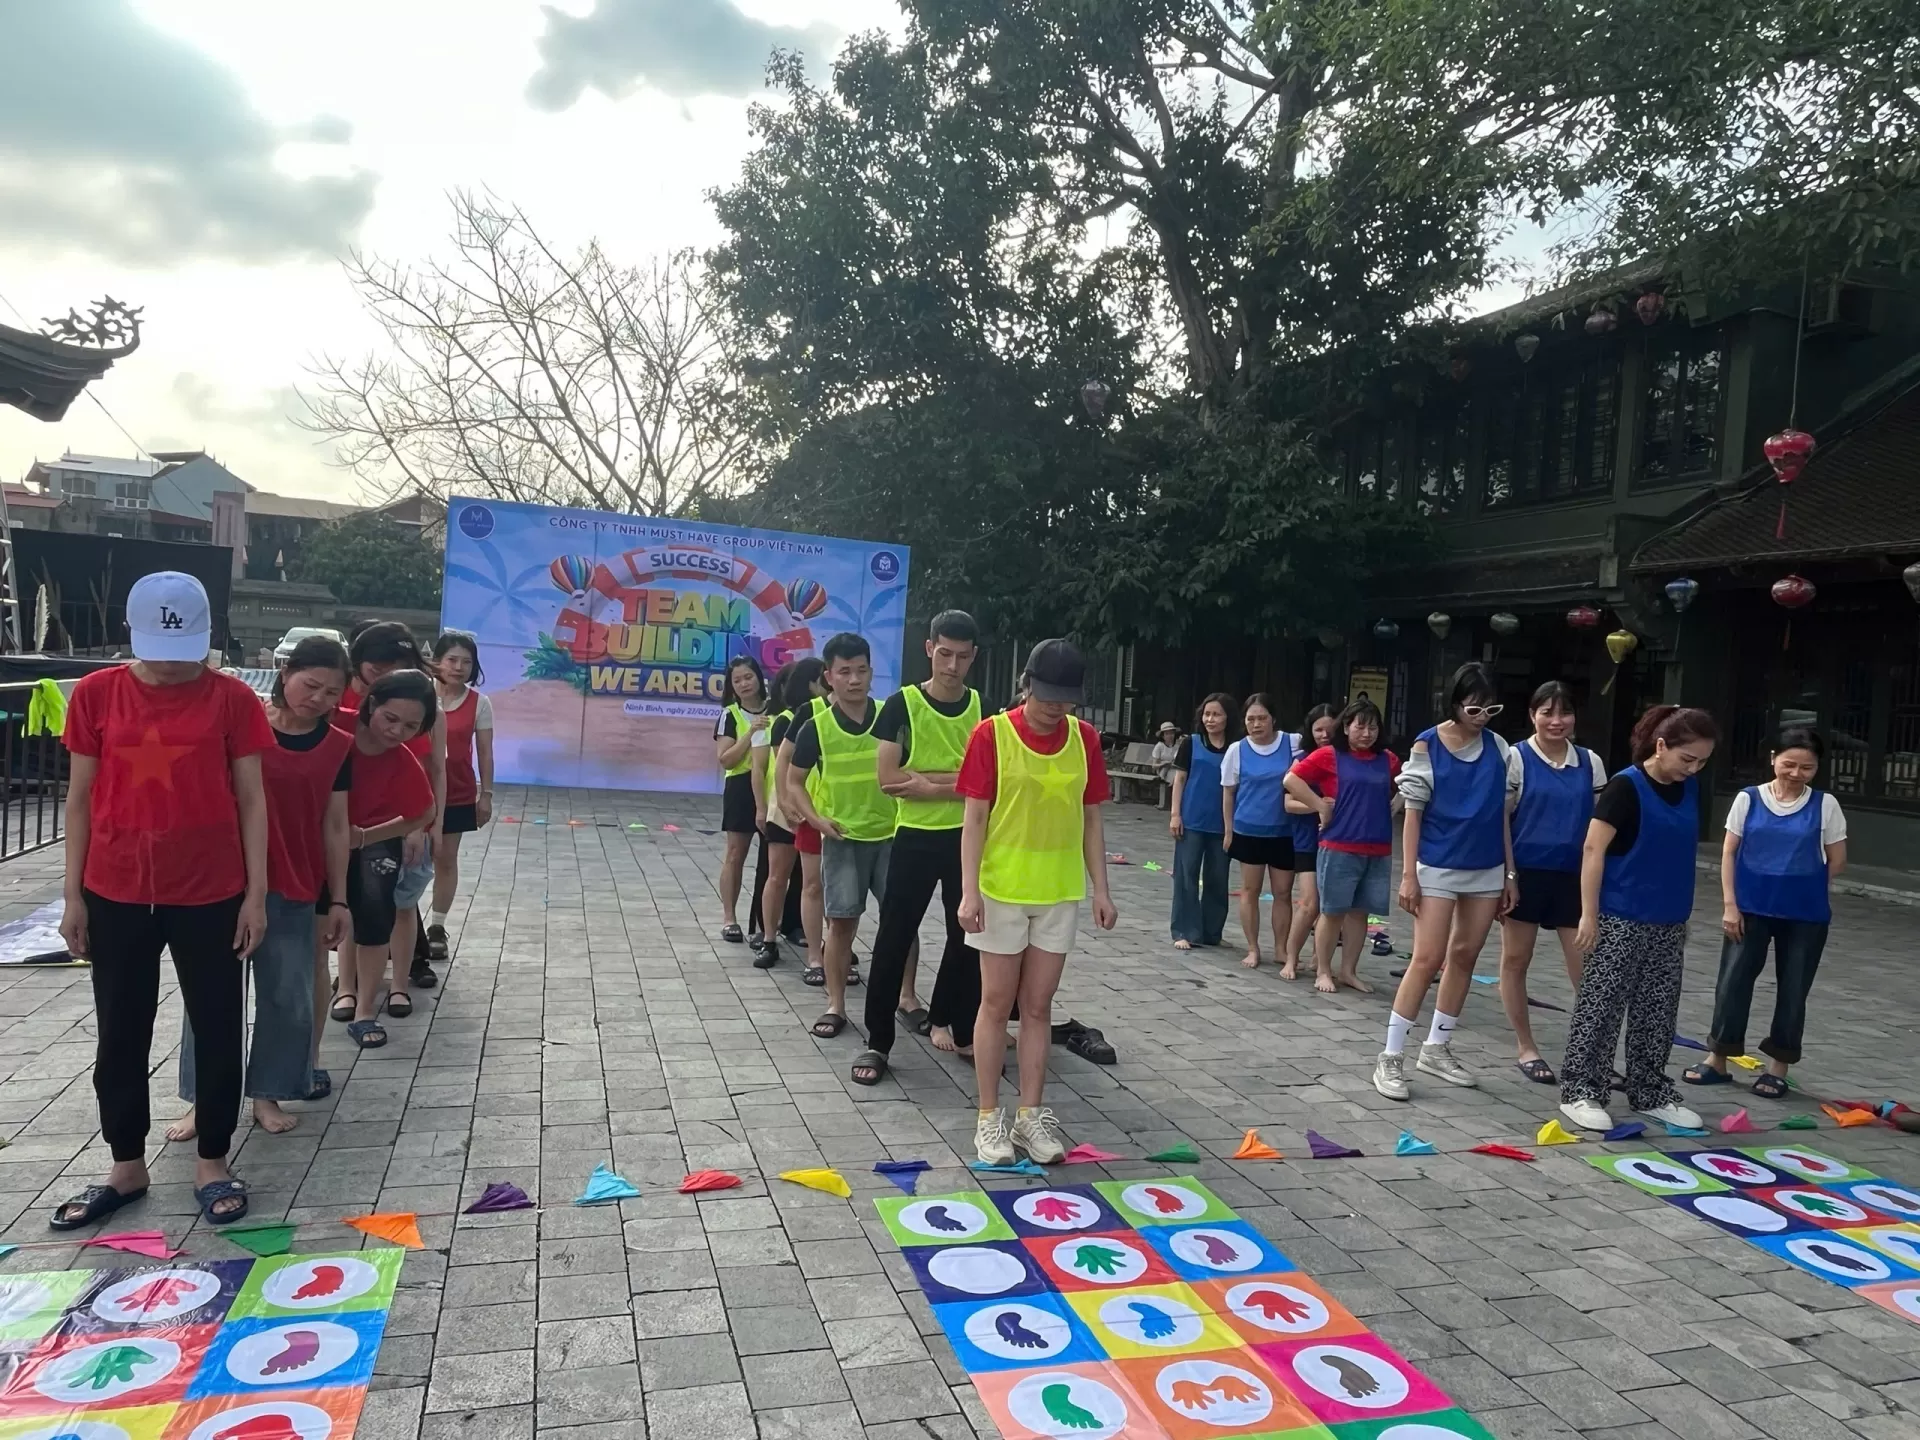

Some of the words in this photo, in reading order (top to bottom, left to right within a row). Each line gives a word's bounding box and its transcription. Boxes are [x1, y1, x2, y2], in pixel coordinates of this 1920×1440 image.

[549, 515, 588, 530] CÔNG
[593, 521, 608, 533] TY
[612, 523, 646, 537] TNHH
[650, 528, 684, 540] MUST
[688, 532, 718, 544] HAVE
[723, 536, 765, 549] GROUP
[797, 544, 823, 556] NAM
[650, 552, 731, 574] SUCCESS
[159, 606, 183, 630] LA
[614, 588, 751, 631] TEAM
[571, 621, 796, 673] BUILDING
[590, 665, 641, 692] WE
[643, 669, 703, 695] ARE
[625, 703, 644, 711] Ninh
